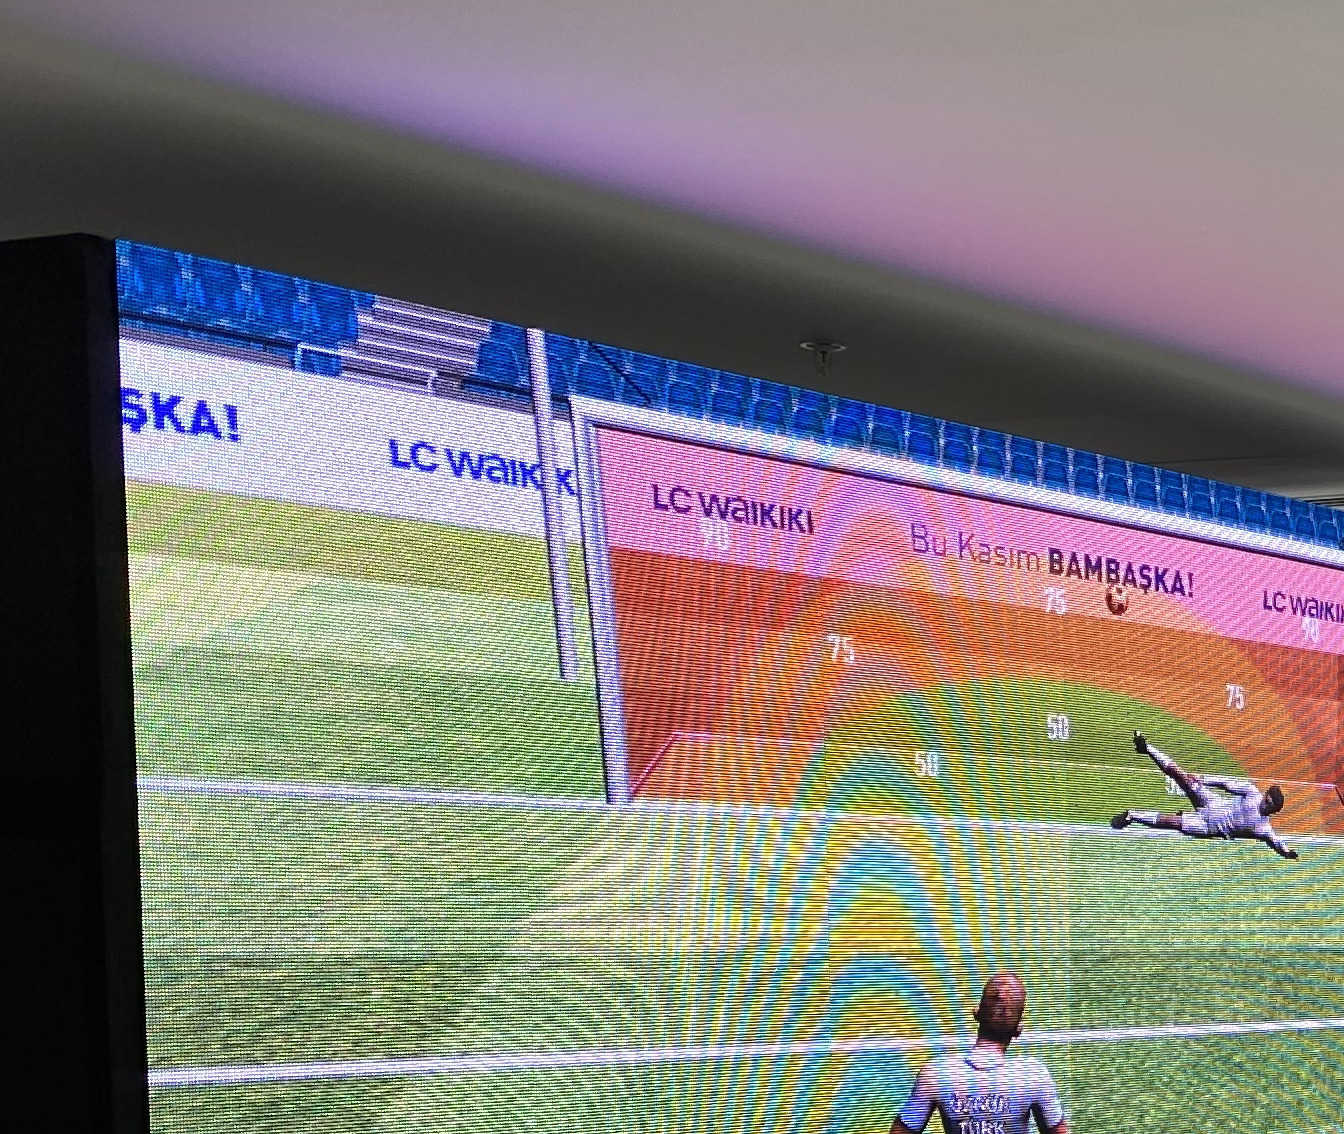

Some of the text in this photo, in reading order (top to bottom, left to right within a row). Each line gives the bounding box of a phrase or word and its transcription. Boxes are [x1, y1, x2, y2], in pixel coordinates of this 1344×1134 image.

[388, 438, 438, 474] LC
[651, 484, 692, 514] LC
[910, 523, 946, 556] Bu
[1048, 547, 1194, 598] BAMBAŞKA!
[1262, 589, 1287, 613] LC
[825, 634, 855, 663] 75
[1225, 683, 1245, 710] 75
[1047, 713, 1070, 741] 50
[914, 751, 939, 777] 50
